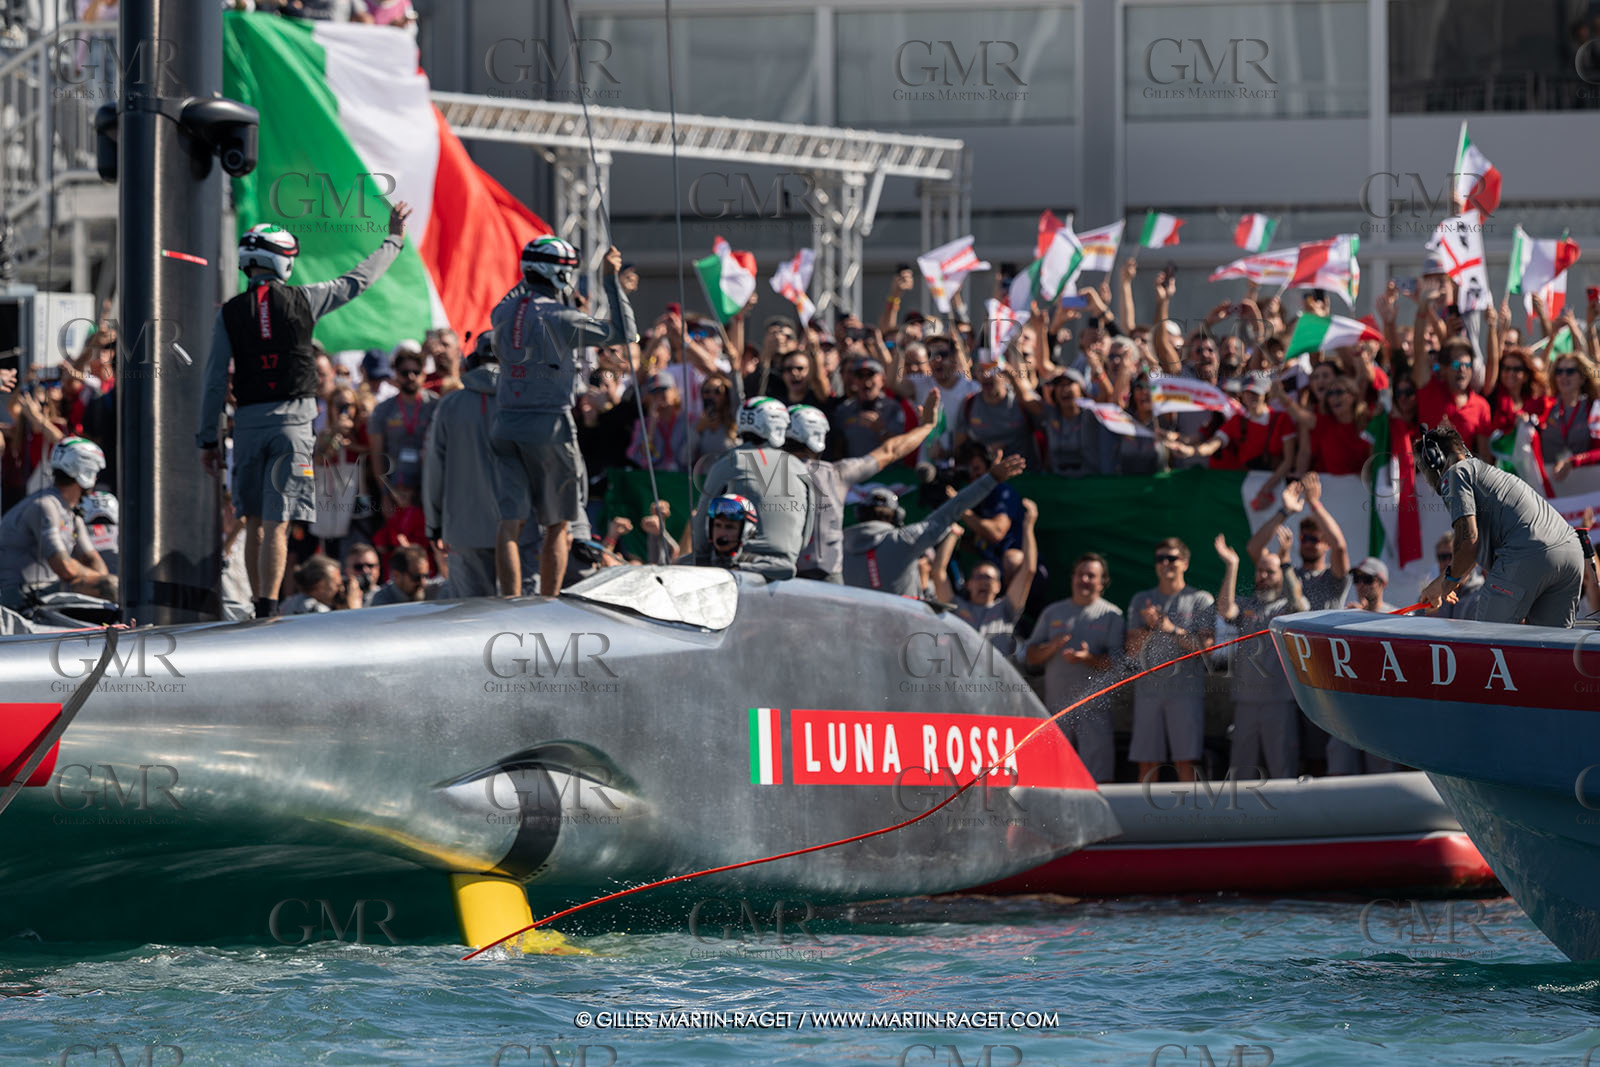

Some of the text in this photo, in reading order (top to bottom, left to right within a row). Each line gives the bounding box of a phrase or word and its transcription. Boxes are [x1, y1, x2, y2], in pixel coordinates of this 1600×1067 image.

[260, 353, 279, 369] 17
[1292, 633, 1518, 692] PRADA
[804, 721, 1018, 776] LUNA ROSSA
